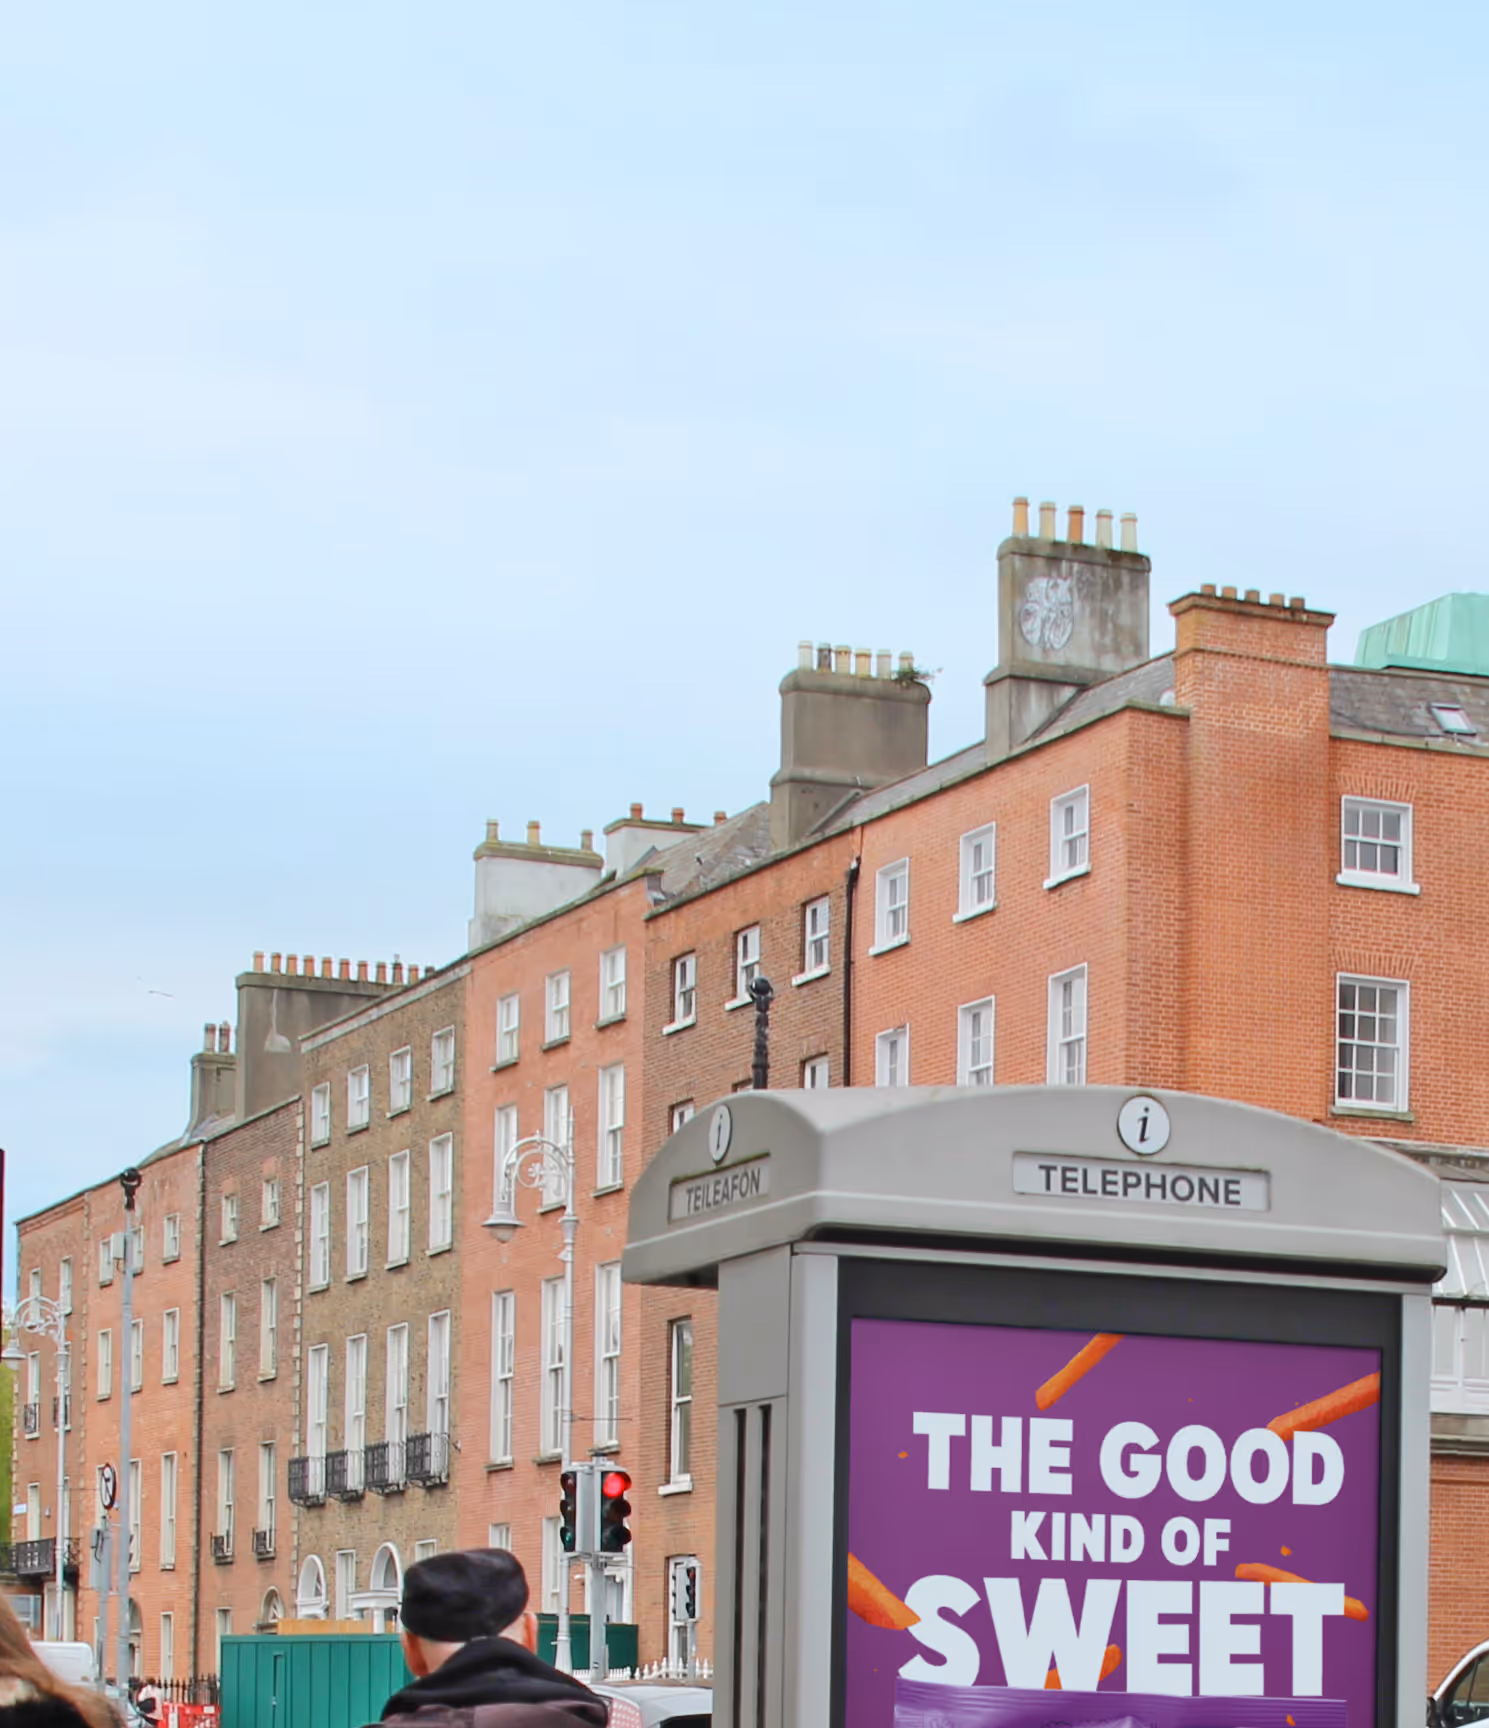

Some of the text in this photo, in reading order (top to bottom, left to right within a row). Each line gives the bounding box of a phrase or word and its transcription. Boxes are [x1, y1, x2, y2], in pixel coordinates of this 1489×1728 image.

[1038, 1164, 1241, 1205] TELEPHONE
[913, 1411, 1345, 1505] THE GOOD
[1011, 1510, 1232, 1566] KIND OF
[897, 1574, 1345, 1697] SWEET
